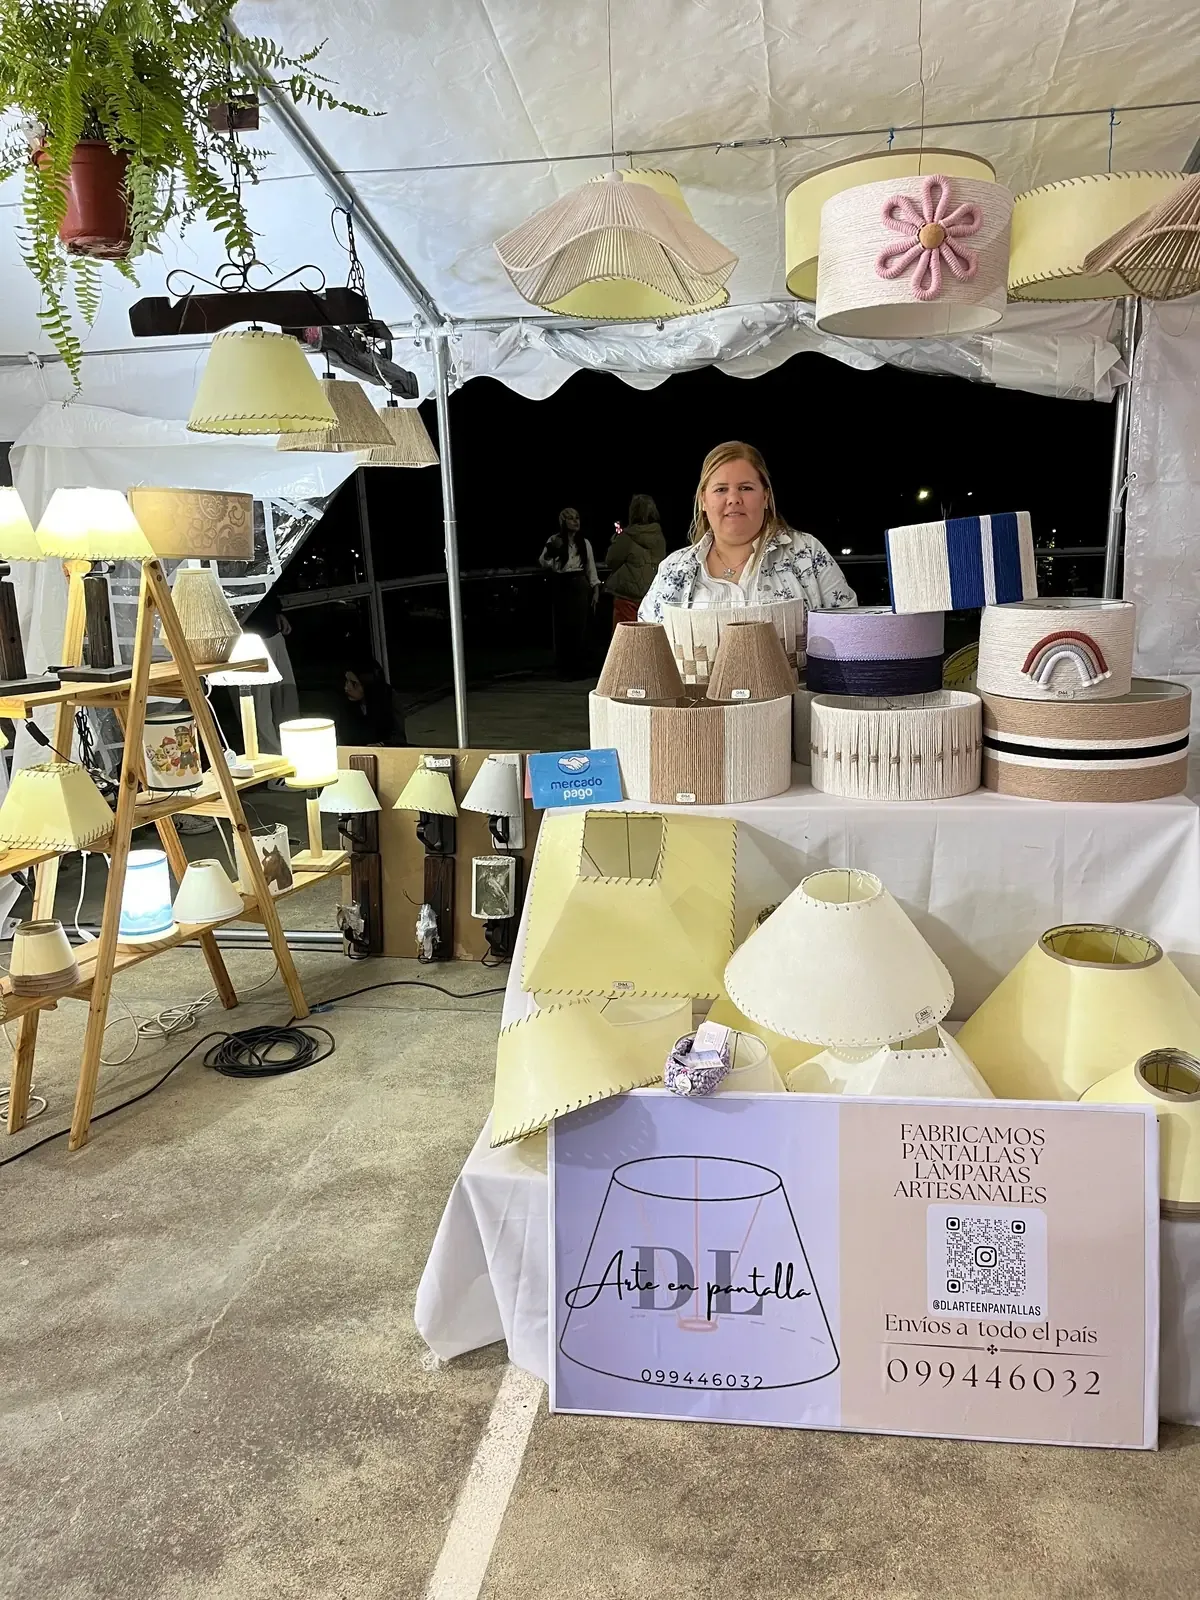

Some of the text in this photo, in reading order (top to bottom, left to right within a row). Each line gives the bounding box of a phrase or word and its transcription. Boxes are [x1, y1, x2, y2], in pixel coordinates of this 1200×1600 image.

[551, 777, 602, 789] mercado
[563, 788, 593, 800] pago
[900, 1123, 1046, 1146] FABRICAMOS
[902, 1143, 1044, 1165] PANTALLAS Y
[915, 1159, 1031, 1184] LÁMPARAS
[893, 1180, 1048, 1205] ARTESANALES
[564, 1249, 812, 1321] Arte en pantalla
[932, 1300, 1041, 1317] @DLARTEENPANTALLAS
[885, 1313, 1098, 1347] Envíos a todo el país
[640, 1368, 764, 1390] 099446032
[887, 1358, 1101, 1398] 099446032
